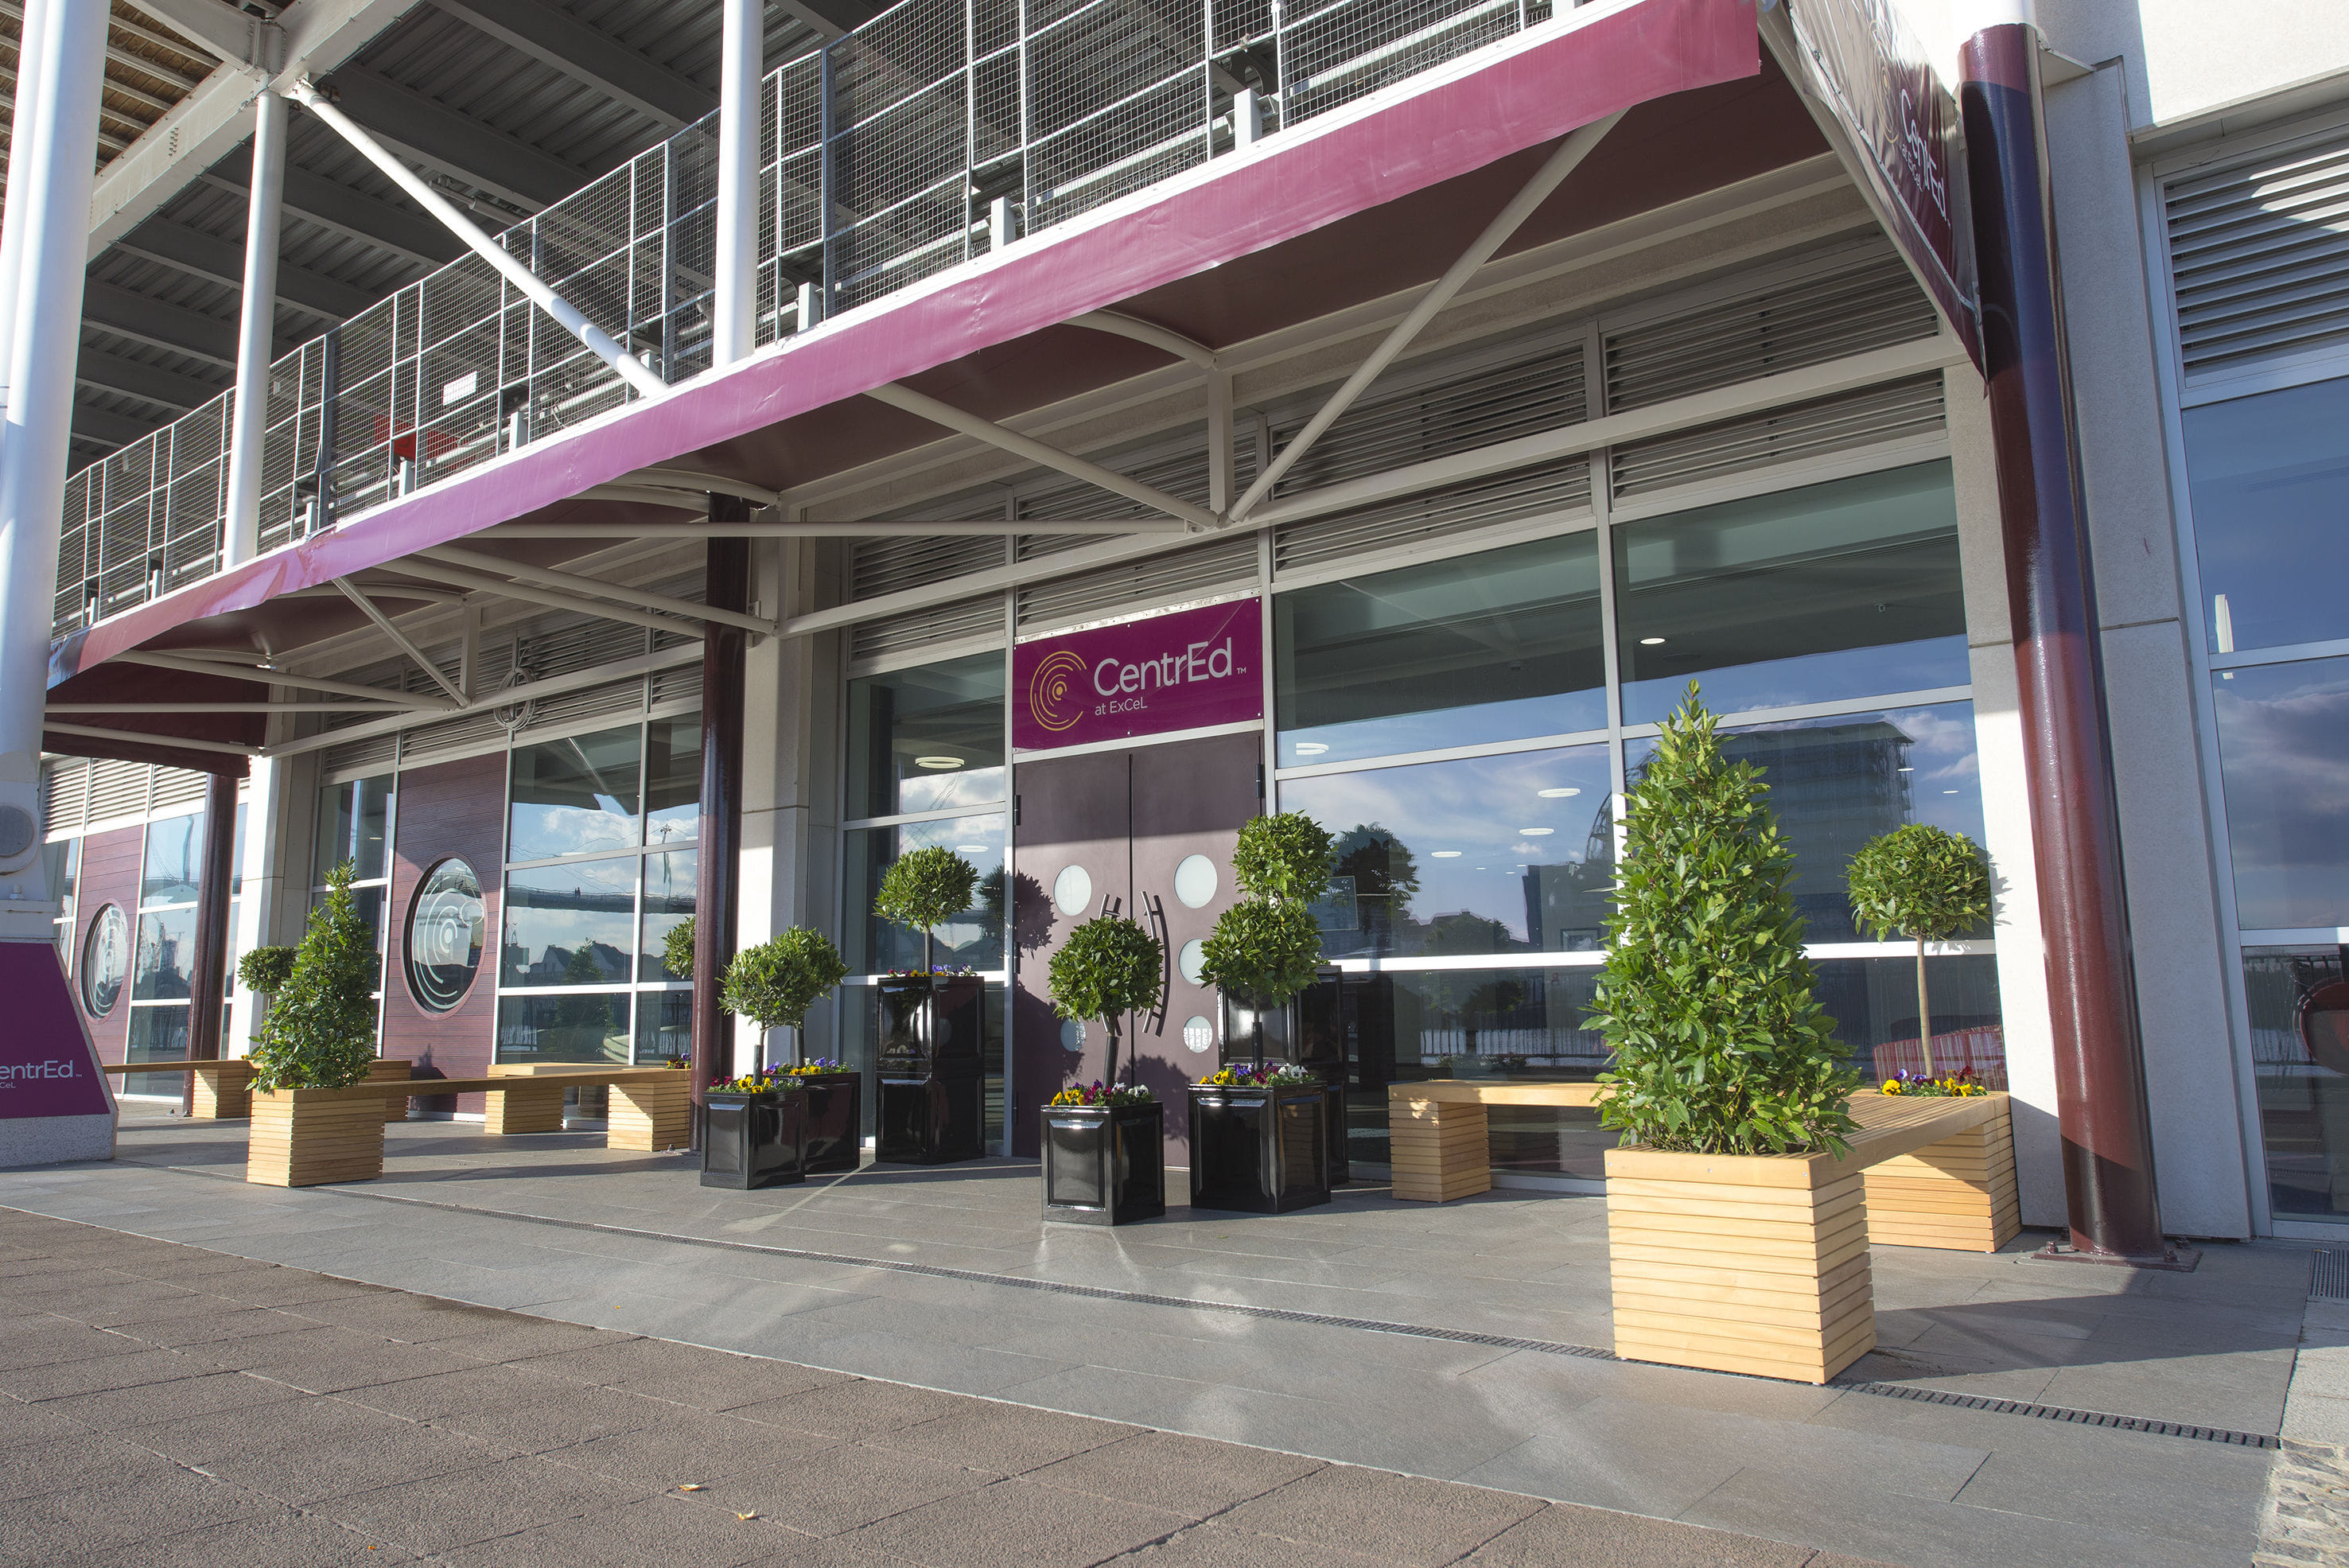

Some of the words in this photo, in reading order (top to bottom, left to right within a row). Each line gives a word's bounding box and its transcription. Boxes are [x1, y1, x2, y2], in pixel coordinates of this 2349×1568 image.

[1094, 637, 1231, 696] CentrEd
[1095, 703, 1106, 716] at
[1110, 697, 1148, 714] ExCeL
[0, 1060, 73, 1080] entrEd
